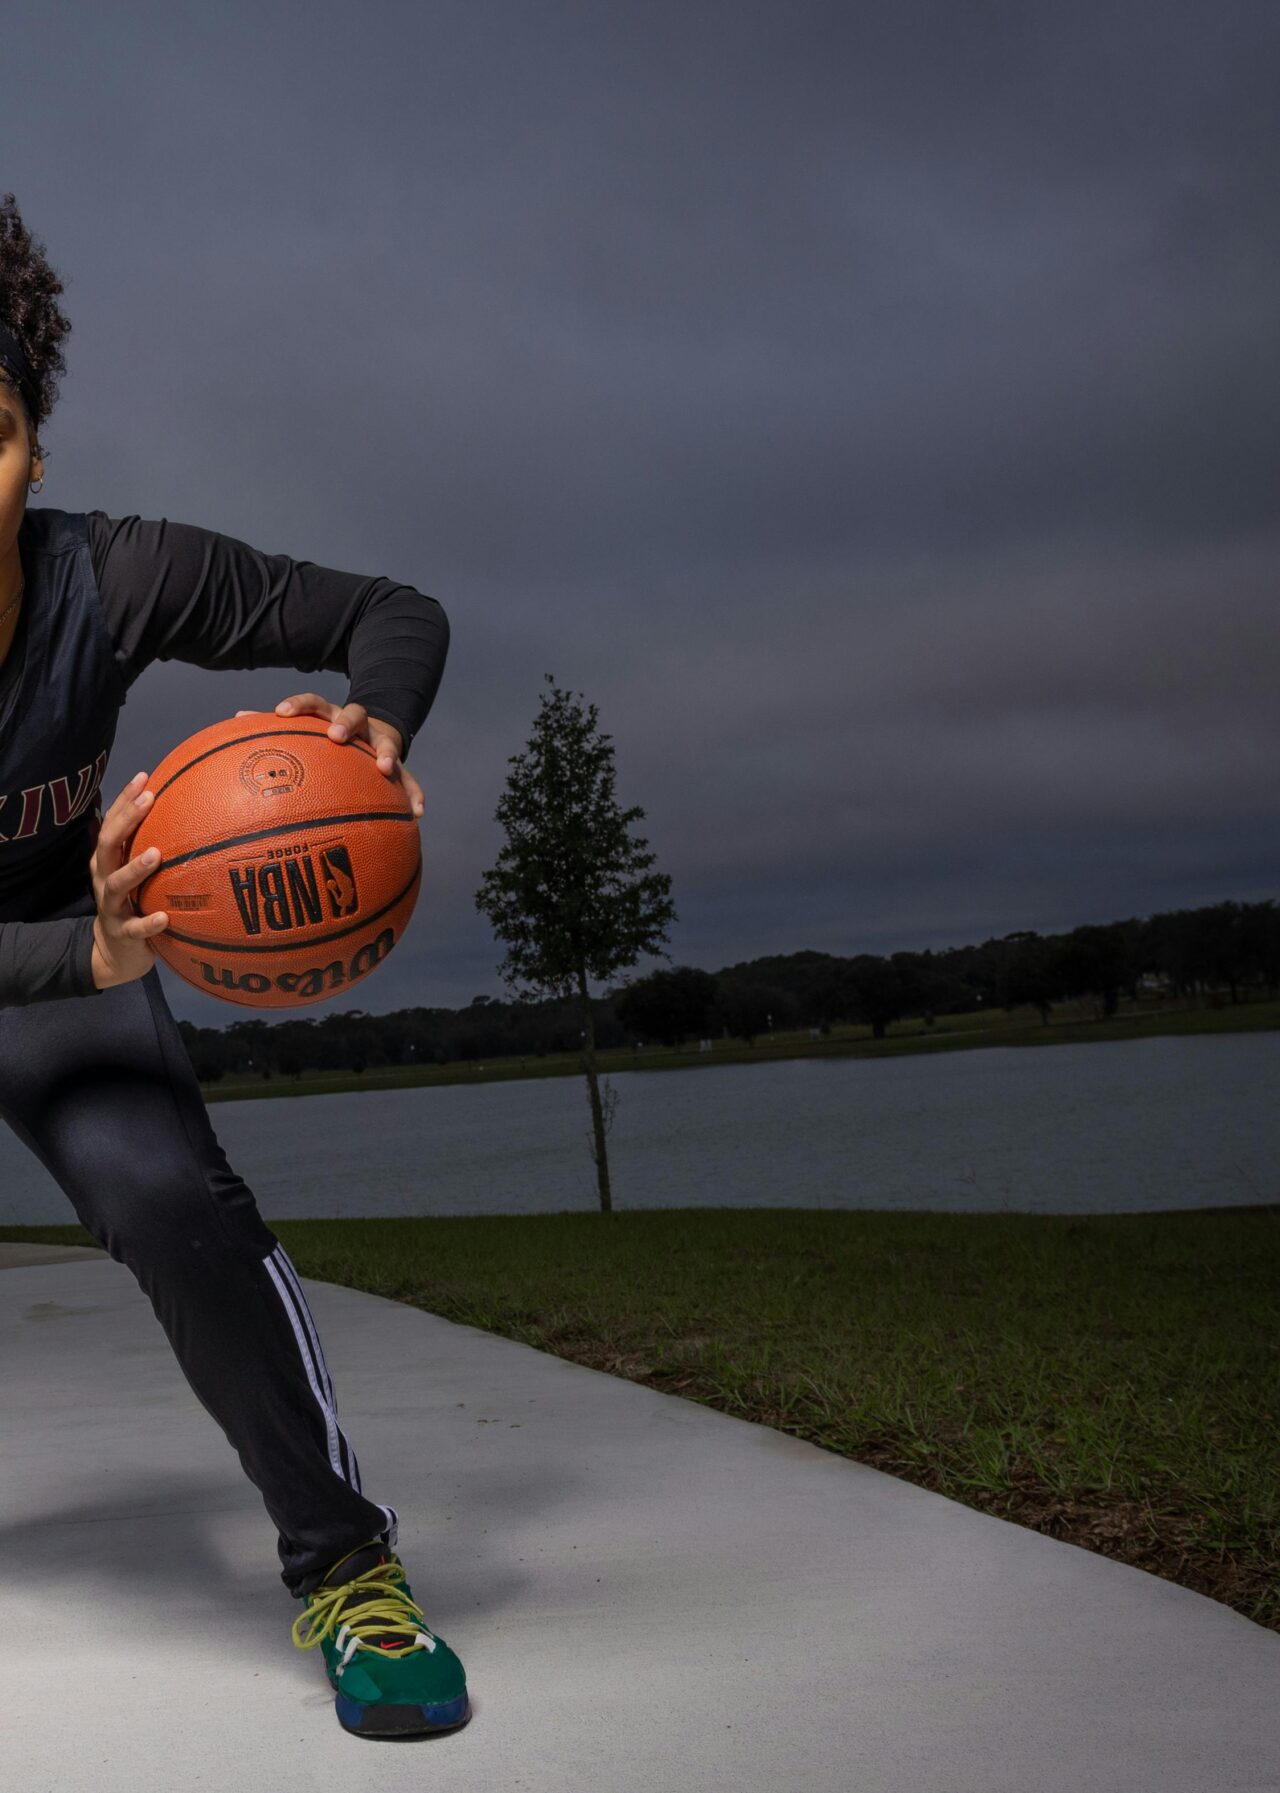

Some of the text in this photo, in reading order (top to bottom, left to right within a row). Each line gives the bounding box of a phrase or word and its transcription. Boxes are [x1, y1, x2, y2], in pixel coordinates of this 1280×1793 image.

[267, 843, 310, 860] FORGE
[230, 855, 324, 935] NBA
[200, 928, 396, 997] Wilson
